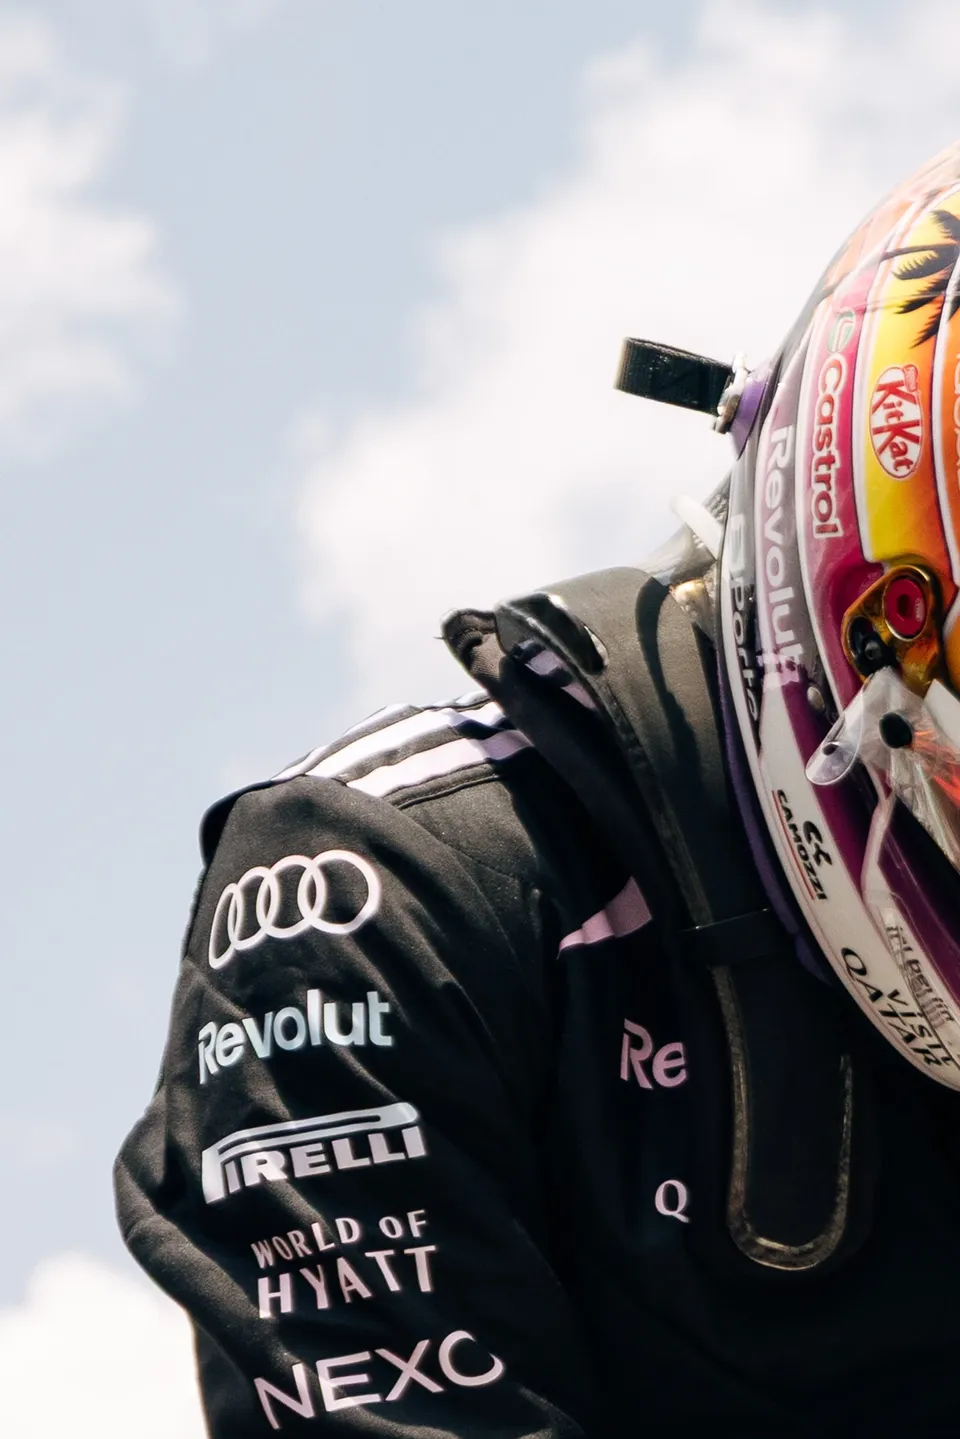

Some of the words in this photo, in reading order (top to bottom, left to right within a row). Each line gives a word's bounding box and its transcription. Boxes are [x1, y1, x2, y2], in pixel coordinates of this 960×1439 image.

[811, 355, 856, 539] Castrol
[764, 424, 804, 664] Revolut
[777, 789, 828, 901] CAMOZZI
[198, 988, 393, 1085] Revolut
[619, 1018, 688, 1090] Re
[841, 947, 942, 1067] QATAR
[201, 1101, 428, 1204] PIRELLI
[654, 1179, 691, 1223] Q
[250, 1216, 361, 1269] WORLD
[377, 1209, 429, 1239] OF
[256, 1245, 438, 1319] HYATT
